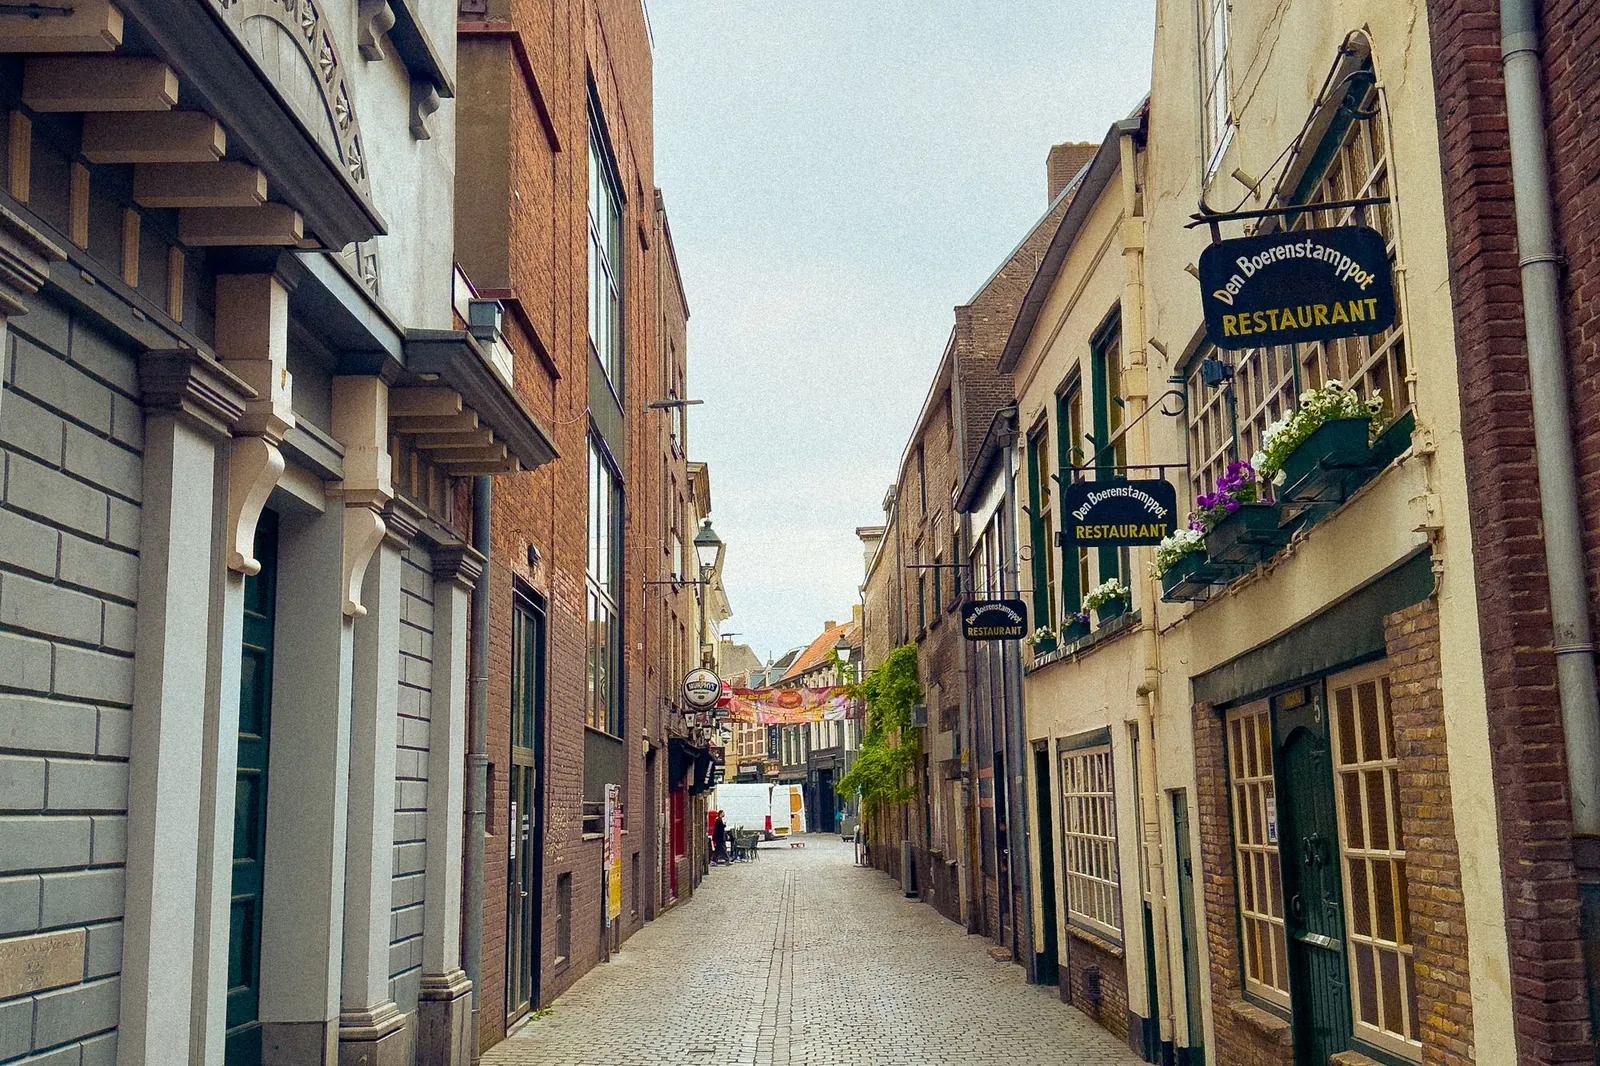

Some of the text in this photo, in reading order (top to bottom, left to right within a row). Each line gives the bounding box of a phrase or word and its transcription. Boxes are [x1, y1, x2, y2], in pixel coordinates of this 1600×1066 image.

[1212, 238, 1376, 306] Den Boerenstamppot
[1222, 298, 1378, 337] RESTAURANT
[1072, 485, 1168, 521] Den Boerenstamppot
[1076, 524, 1168, 539] RESTAURANT
[965, 603, 1022, 625] Den Boerenstamppot
[967, 626, 1022, 636] RESTAURANT
[1313, 695, 1321, 723] 5
